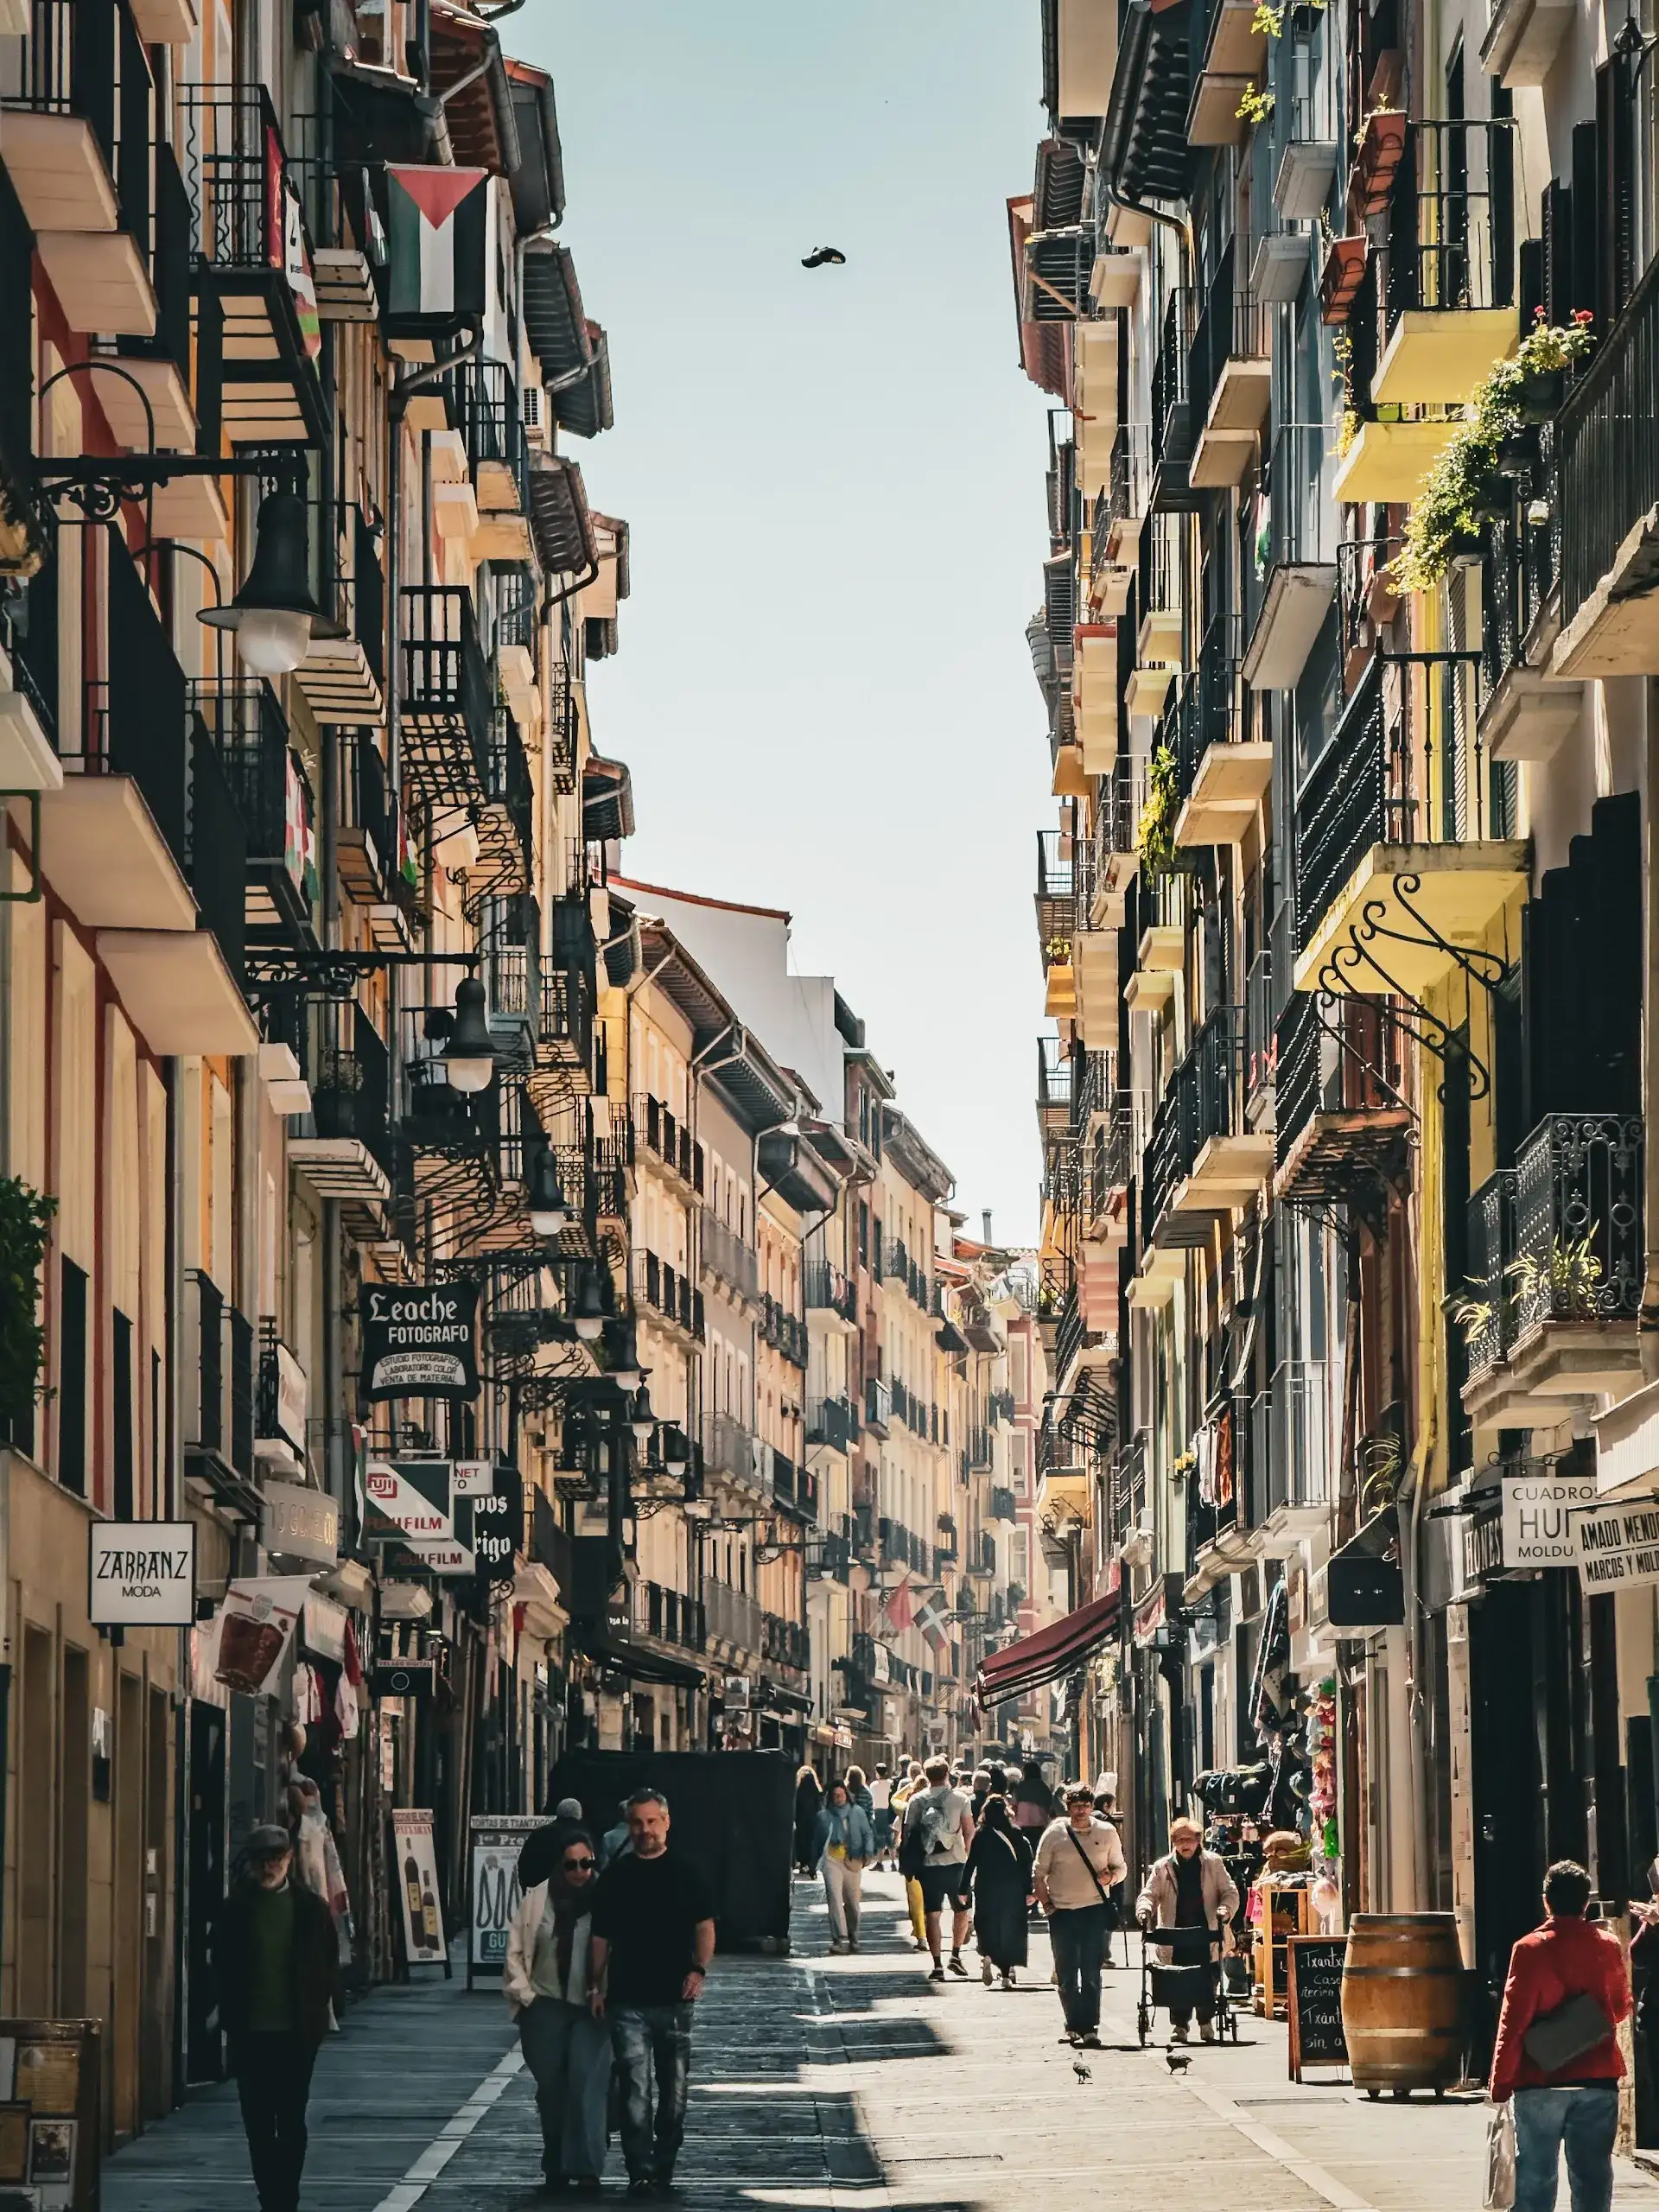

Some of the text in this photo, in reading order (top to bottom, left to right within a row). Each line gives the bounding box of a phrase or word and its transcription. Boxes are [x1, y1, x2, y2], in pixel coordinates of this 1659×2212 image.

[388, 1325, 469, 1344] FOTOGRAFO
[380, 1355, 410, 1367] ESTUDIO
[385, 1363, 457, 1376] LABORATORIO COLOR
[380, 1375, 404, 1385] VENTA
[420, 1374, 456, 1384] MATERIAL
[454, 1468, 480, 1478] NET
[1580, 1519, 1621, 1551] AMADO
[474, 1530, 512, 1563] rigo
[1518, 1545, 1573, 1558] MOLDU
[97, 1551, 188, 1583] ZARRANZ
[1585, 1551, 1659, 1583] MARCOS Y MOLD
[122, 1586, 162, 1598] MODA
[499, 1834, 529, 1847] Pre
[489, 1933, 507, 1948] GU
[1300, 1947, 1344, 1968] Txantxi
[1313, 1974, 1341, 1985] Case
